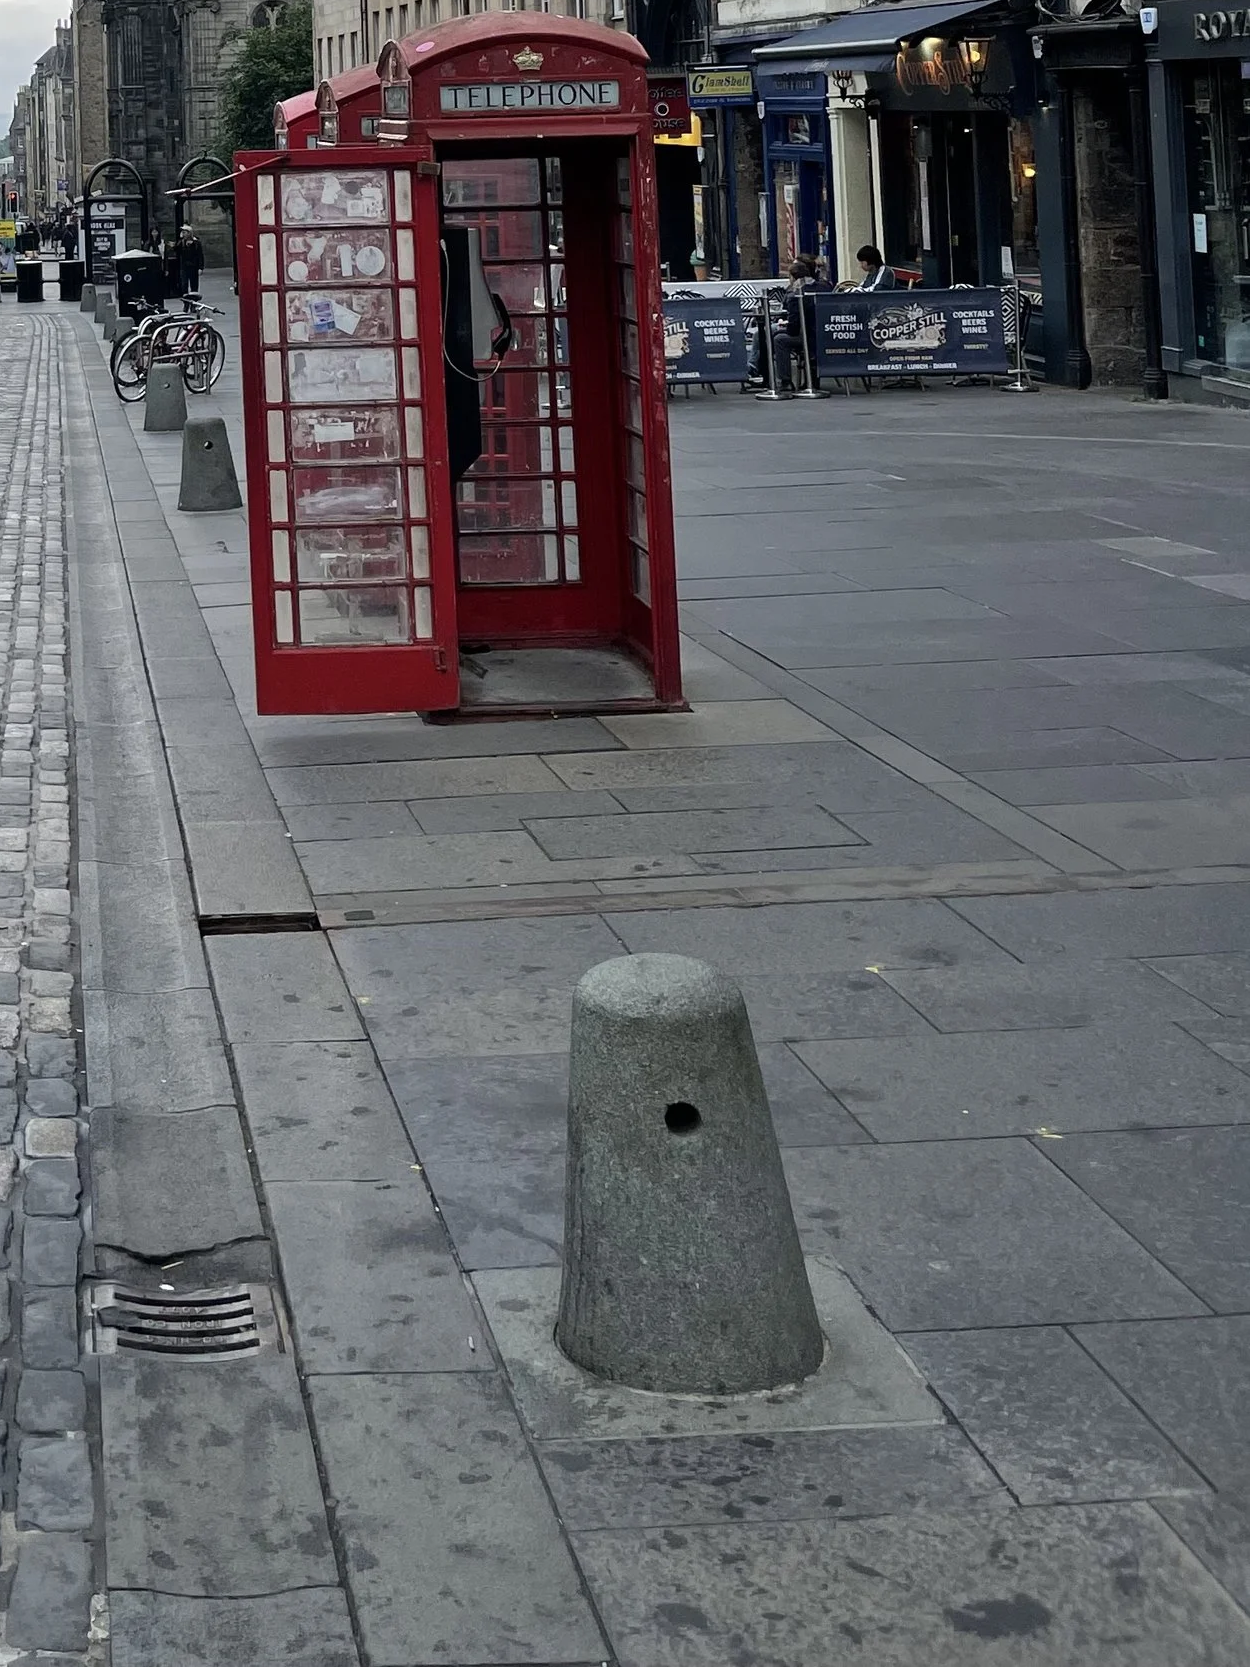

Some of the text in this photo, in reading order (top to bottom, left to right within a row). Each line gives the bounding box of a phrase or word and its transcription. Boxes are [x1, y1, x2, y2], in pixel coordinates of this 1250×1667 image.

[448, 83, 612, 109] TELEPHONE
[650, 88, 683, 99] offee
[652, 118, 686, 129] ouse
[952, 310, 995, 319] COCKTAILS
[694, 319, 735, 327] COCKTAILS
[831, 315, 856, 323] FRESH
[962, 318, 986, 326] BEERS
[824, 323, 863, 332] SCOTTISH
[873, 312, 947, 340] COPPER STILL
[962, 326, 987, 334] WINES
[704, 327, 728, 335] BEERS
[833, 332, 856, 340] FOOD
